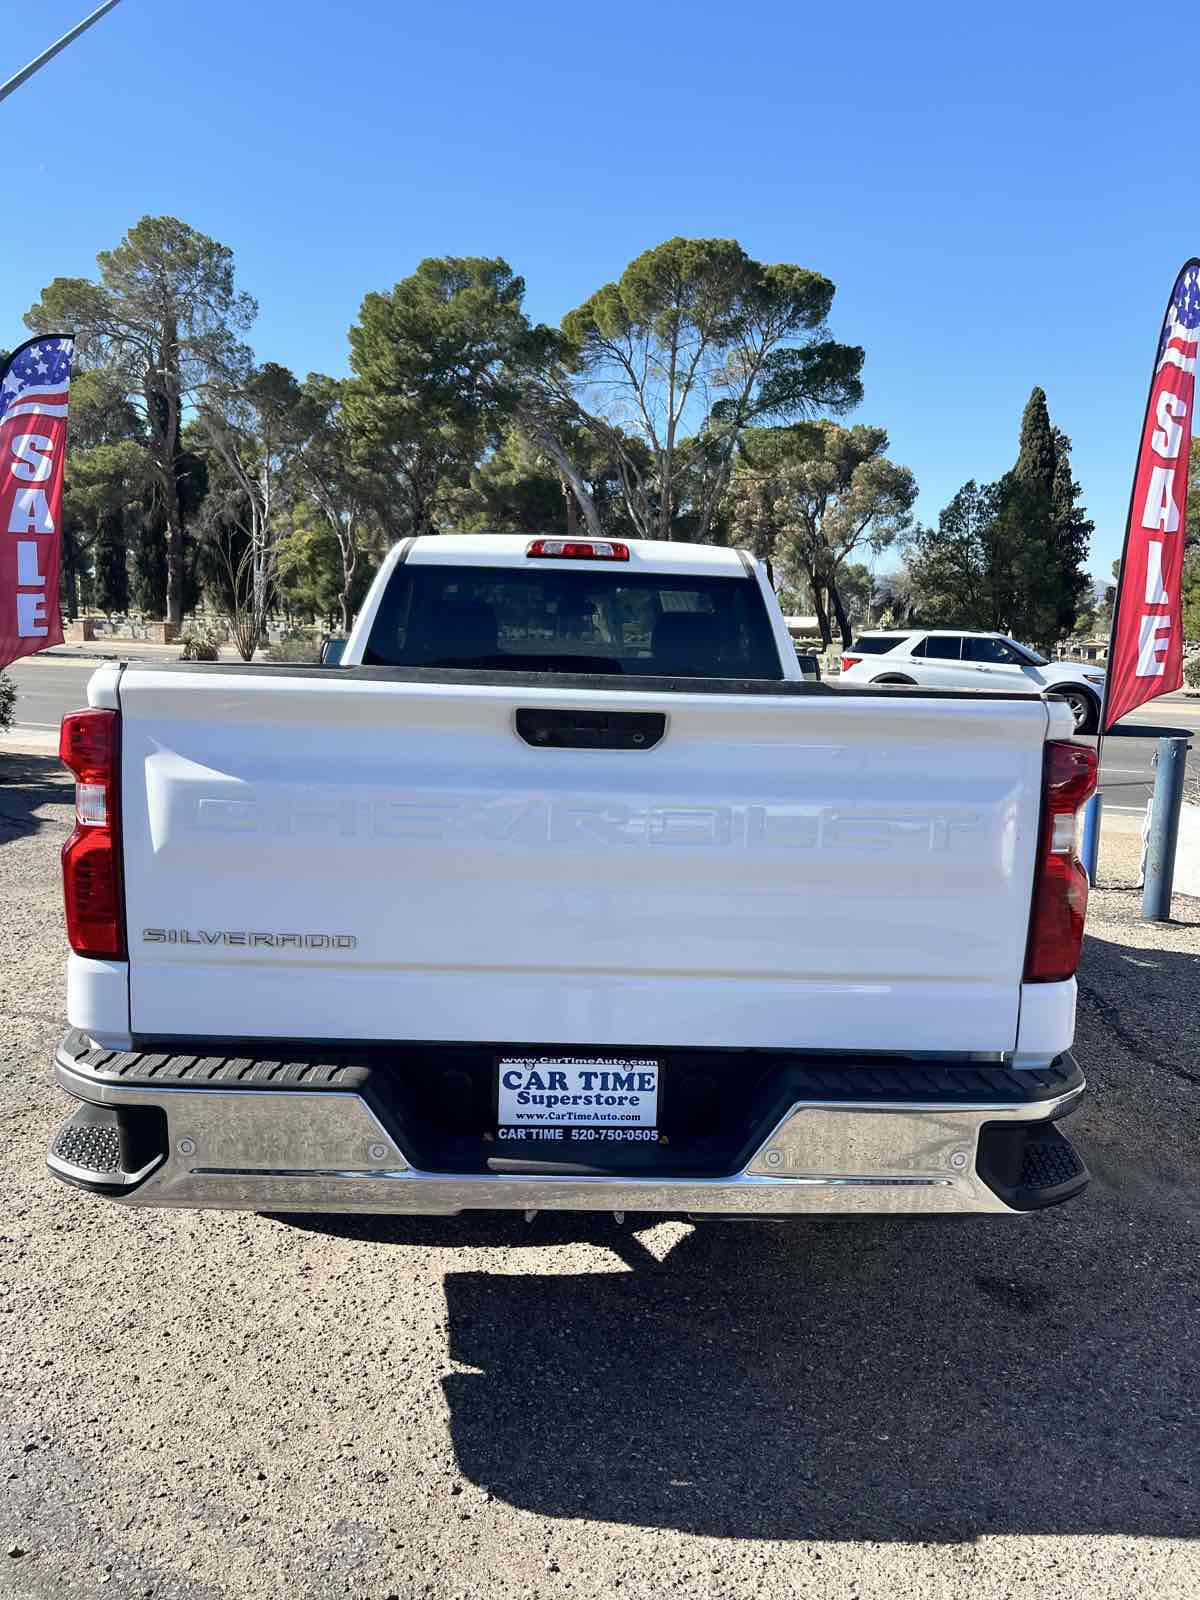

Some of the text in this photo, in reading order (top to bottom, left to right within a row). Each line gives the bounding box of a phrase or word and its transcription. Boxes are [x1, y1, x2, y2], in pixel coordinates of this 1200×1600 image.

[8, 435, 55, 637] SALE
[1136, 391, 1187, 677] SALE
[190, 794, 985, 852] CHEVROLET
[142, 928, 358, 949] SILVERADO
[502, 1057, 658, 1066] www.CarTimeAuto.com
[502, 1070, 656, 1092] CAR TIME
[516, 1091, 640, 1108] Superstore
[516, 1111, 641, 1121] www.CarTimeAuto.com
[498, 1128, 659, 1141] CAR TIME 520-750-0505
